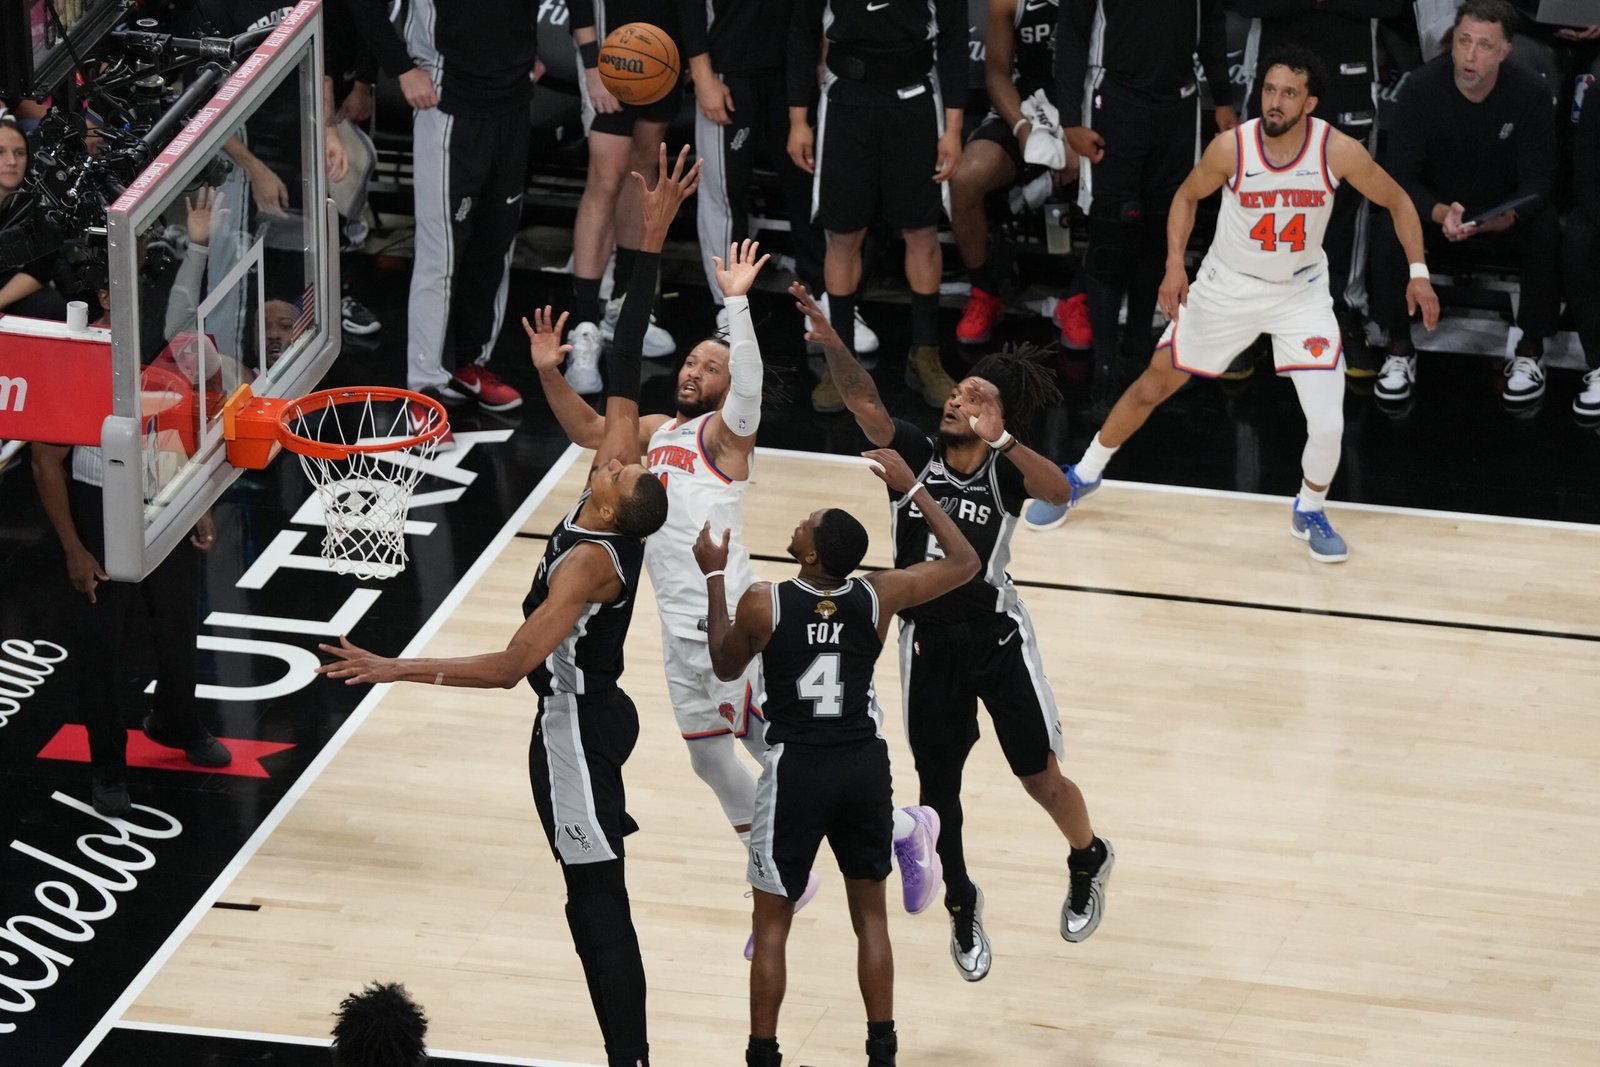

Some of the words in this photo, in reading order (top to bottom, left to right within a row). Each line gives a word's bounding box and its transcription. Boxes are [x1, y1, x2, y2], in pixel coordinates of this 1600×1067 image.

[284, 0, 317, 25] Emirates
[236, 53, 270, 79] Emirates
[600, 53, 644, 74] Wilson
[216, 86, 240, 101] BETTER
[186, 107, 221, 133] Emirates
[165, 140, 189, 156] BETTER
[134, 162, 169, 189] Emirates
[112, 195, 136, 211] BETTER
[1239, 190, 1278, 209] NEW
[1277, 189, 1326, 208] YORK
[1250, 212, 1307, 253] 44
[660, 445, 698, 474] YORK
[144, 428, 515, 702] ULTRA
[806, 622, 845, 646] FOX
[796, 652, 845, 718] 4
